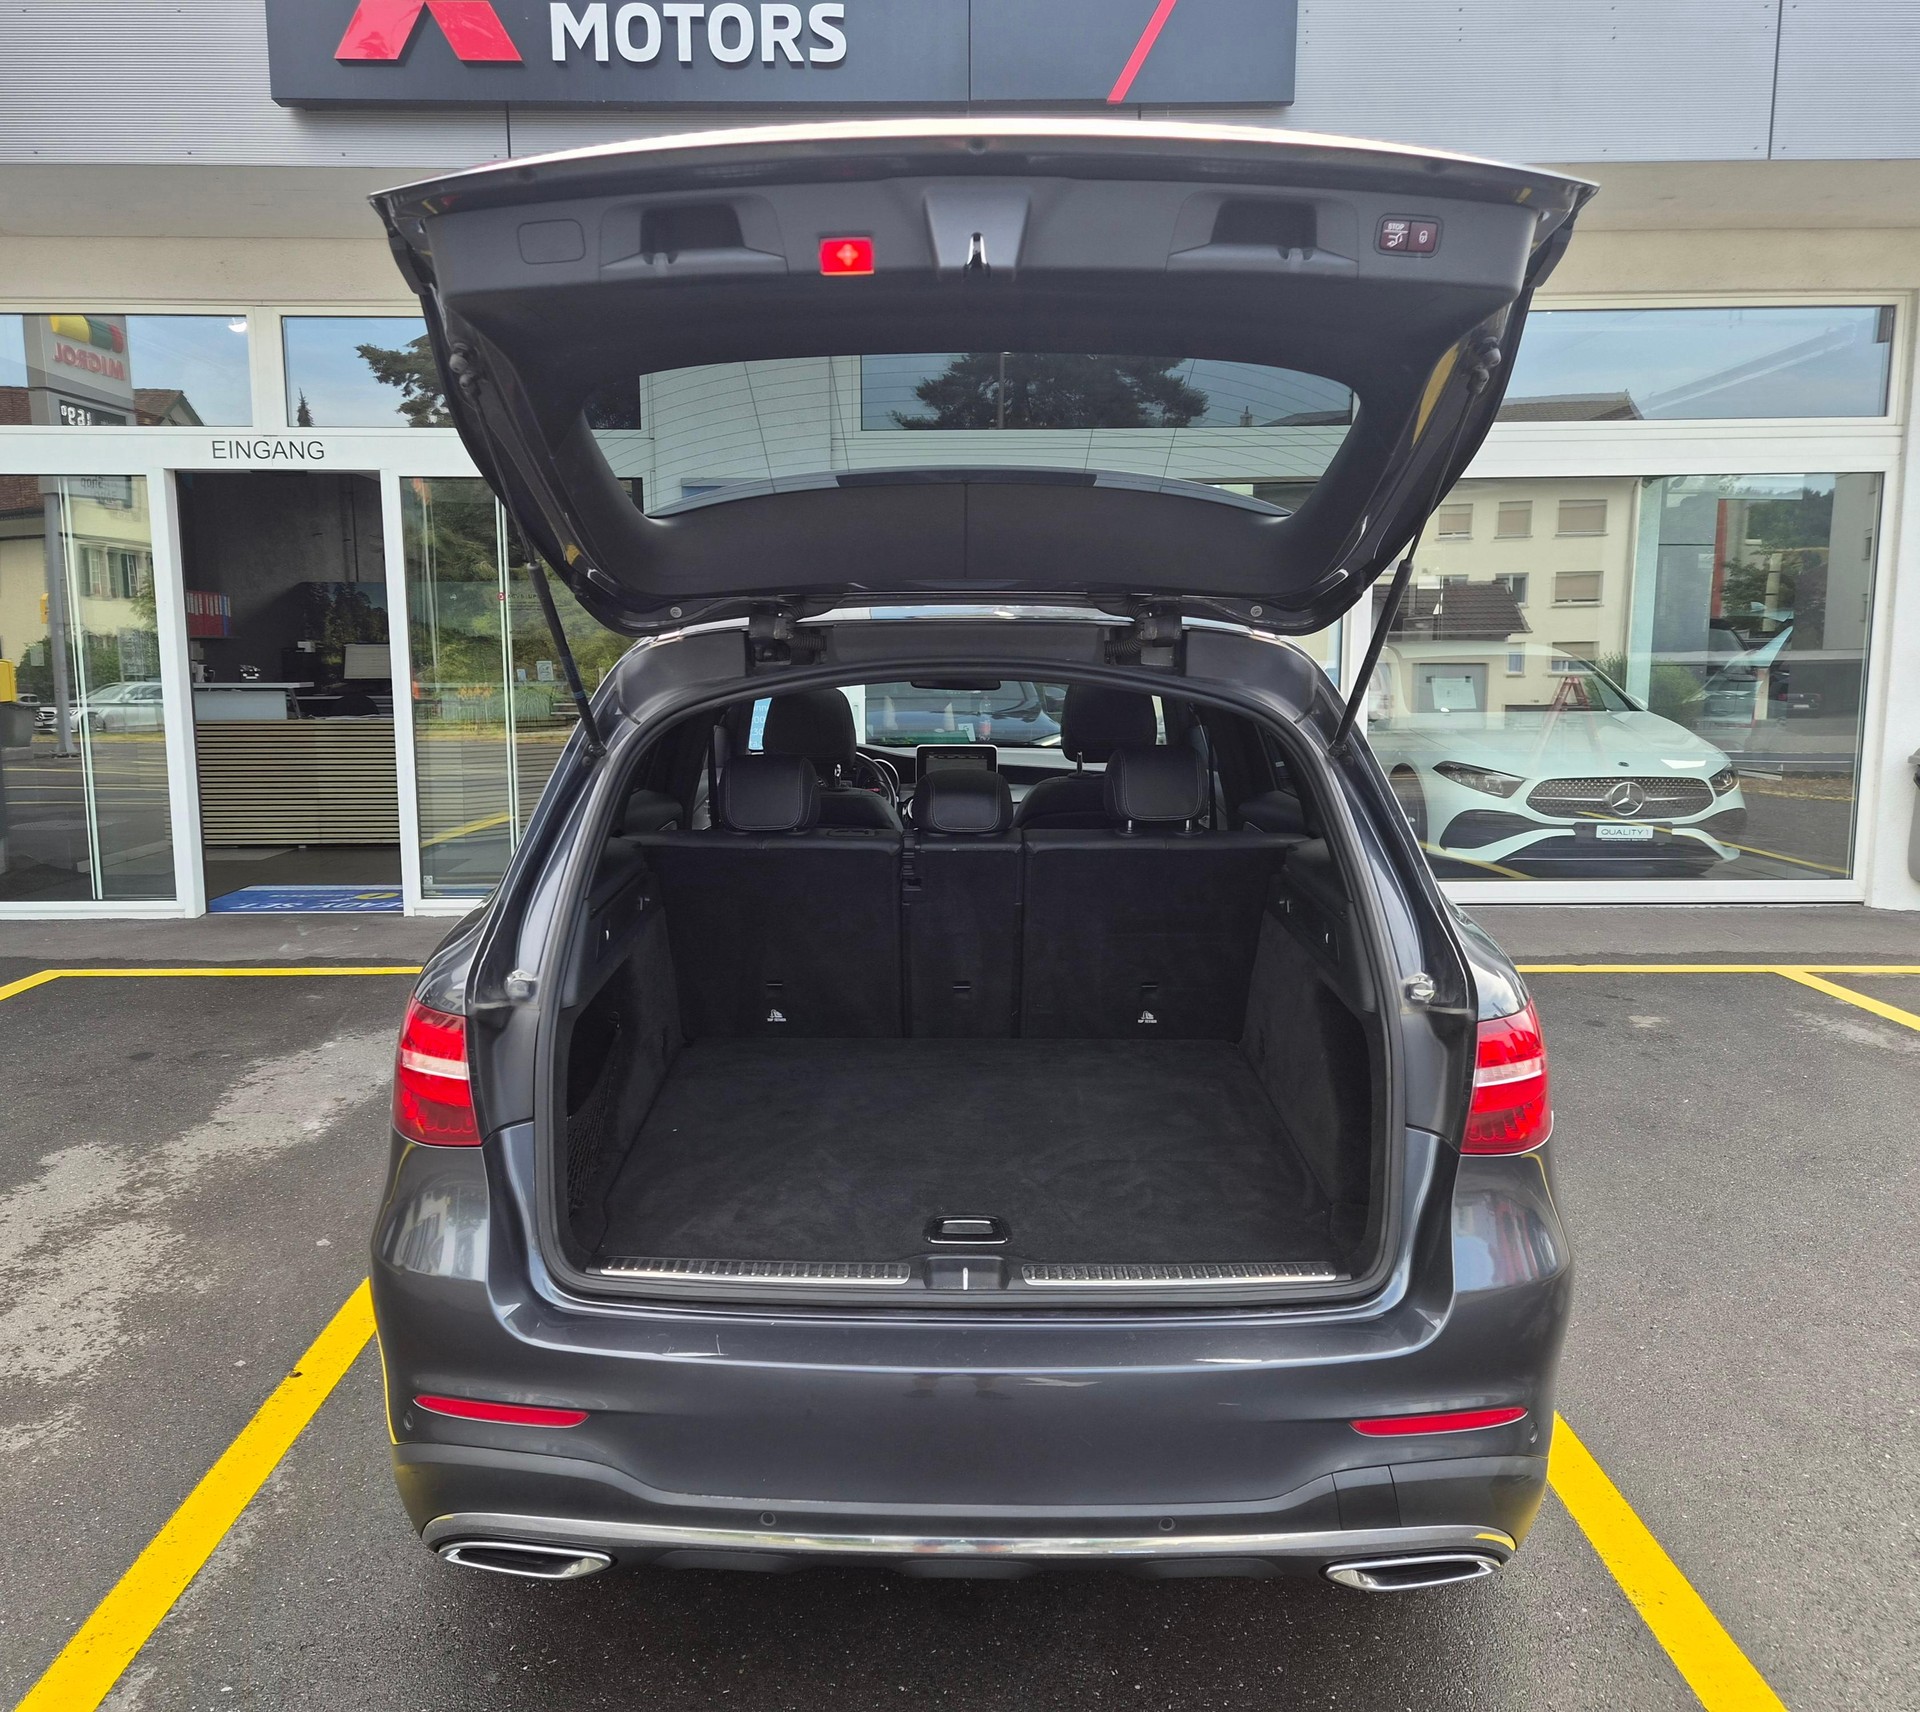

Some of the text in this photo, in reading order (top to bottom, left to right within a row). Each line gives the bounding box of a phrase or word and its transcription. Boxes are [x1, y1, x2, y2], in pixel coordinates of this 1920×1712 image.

[550, 2, 847, 63] MOTORS
[1387, 222, 1405, 230] STOP
[212, 440, 325, 460] EINGANG
[1601, 828, 1644, 836] QUALITY
